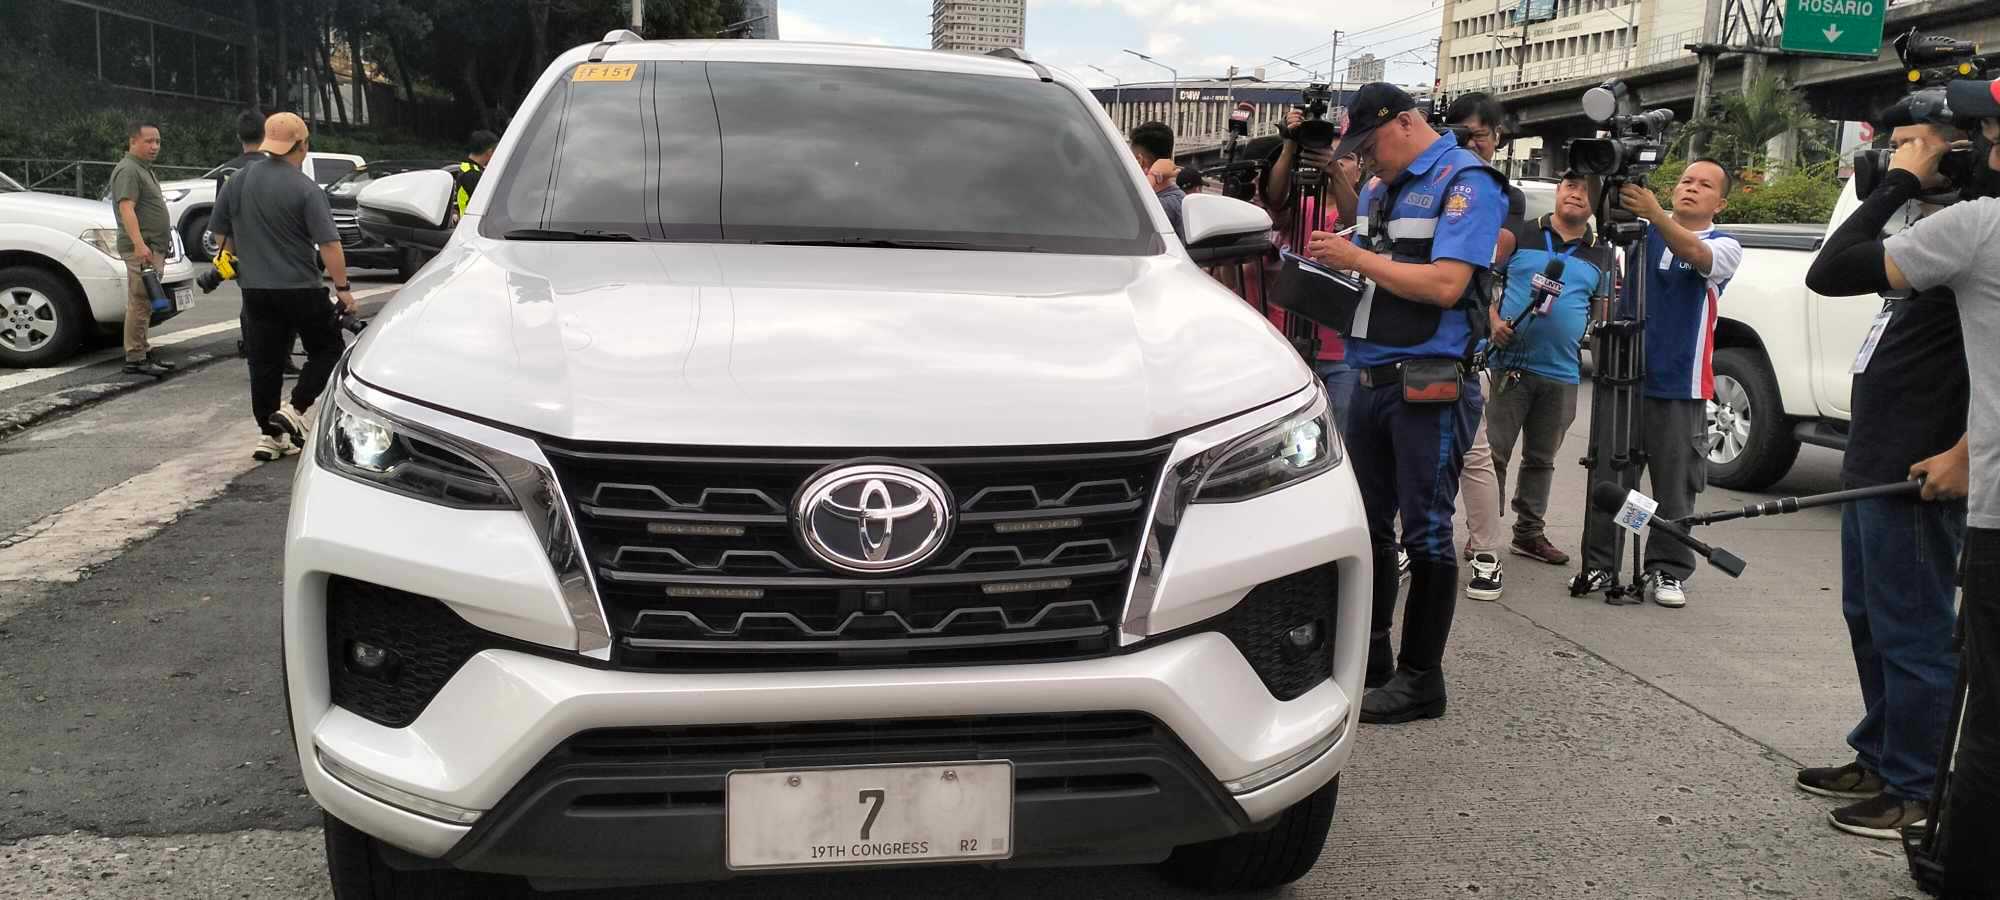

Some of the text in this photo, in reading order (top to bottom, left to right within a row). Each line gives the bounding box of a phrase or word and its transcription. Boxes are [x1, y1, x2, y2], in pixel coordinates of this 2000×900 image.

[1798, 0, 1873, 16] ROSARIO
[858, 789, 885, 841] 7
[811, 841, 929, 858] 19TH CONGRESS
[960, 839, 978, 852] R2
